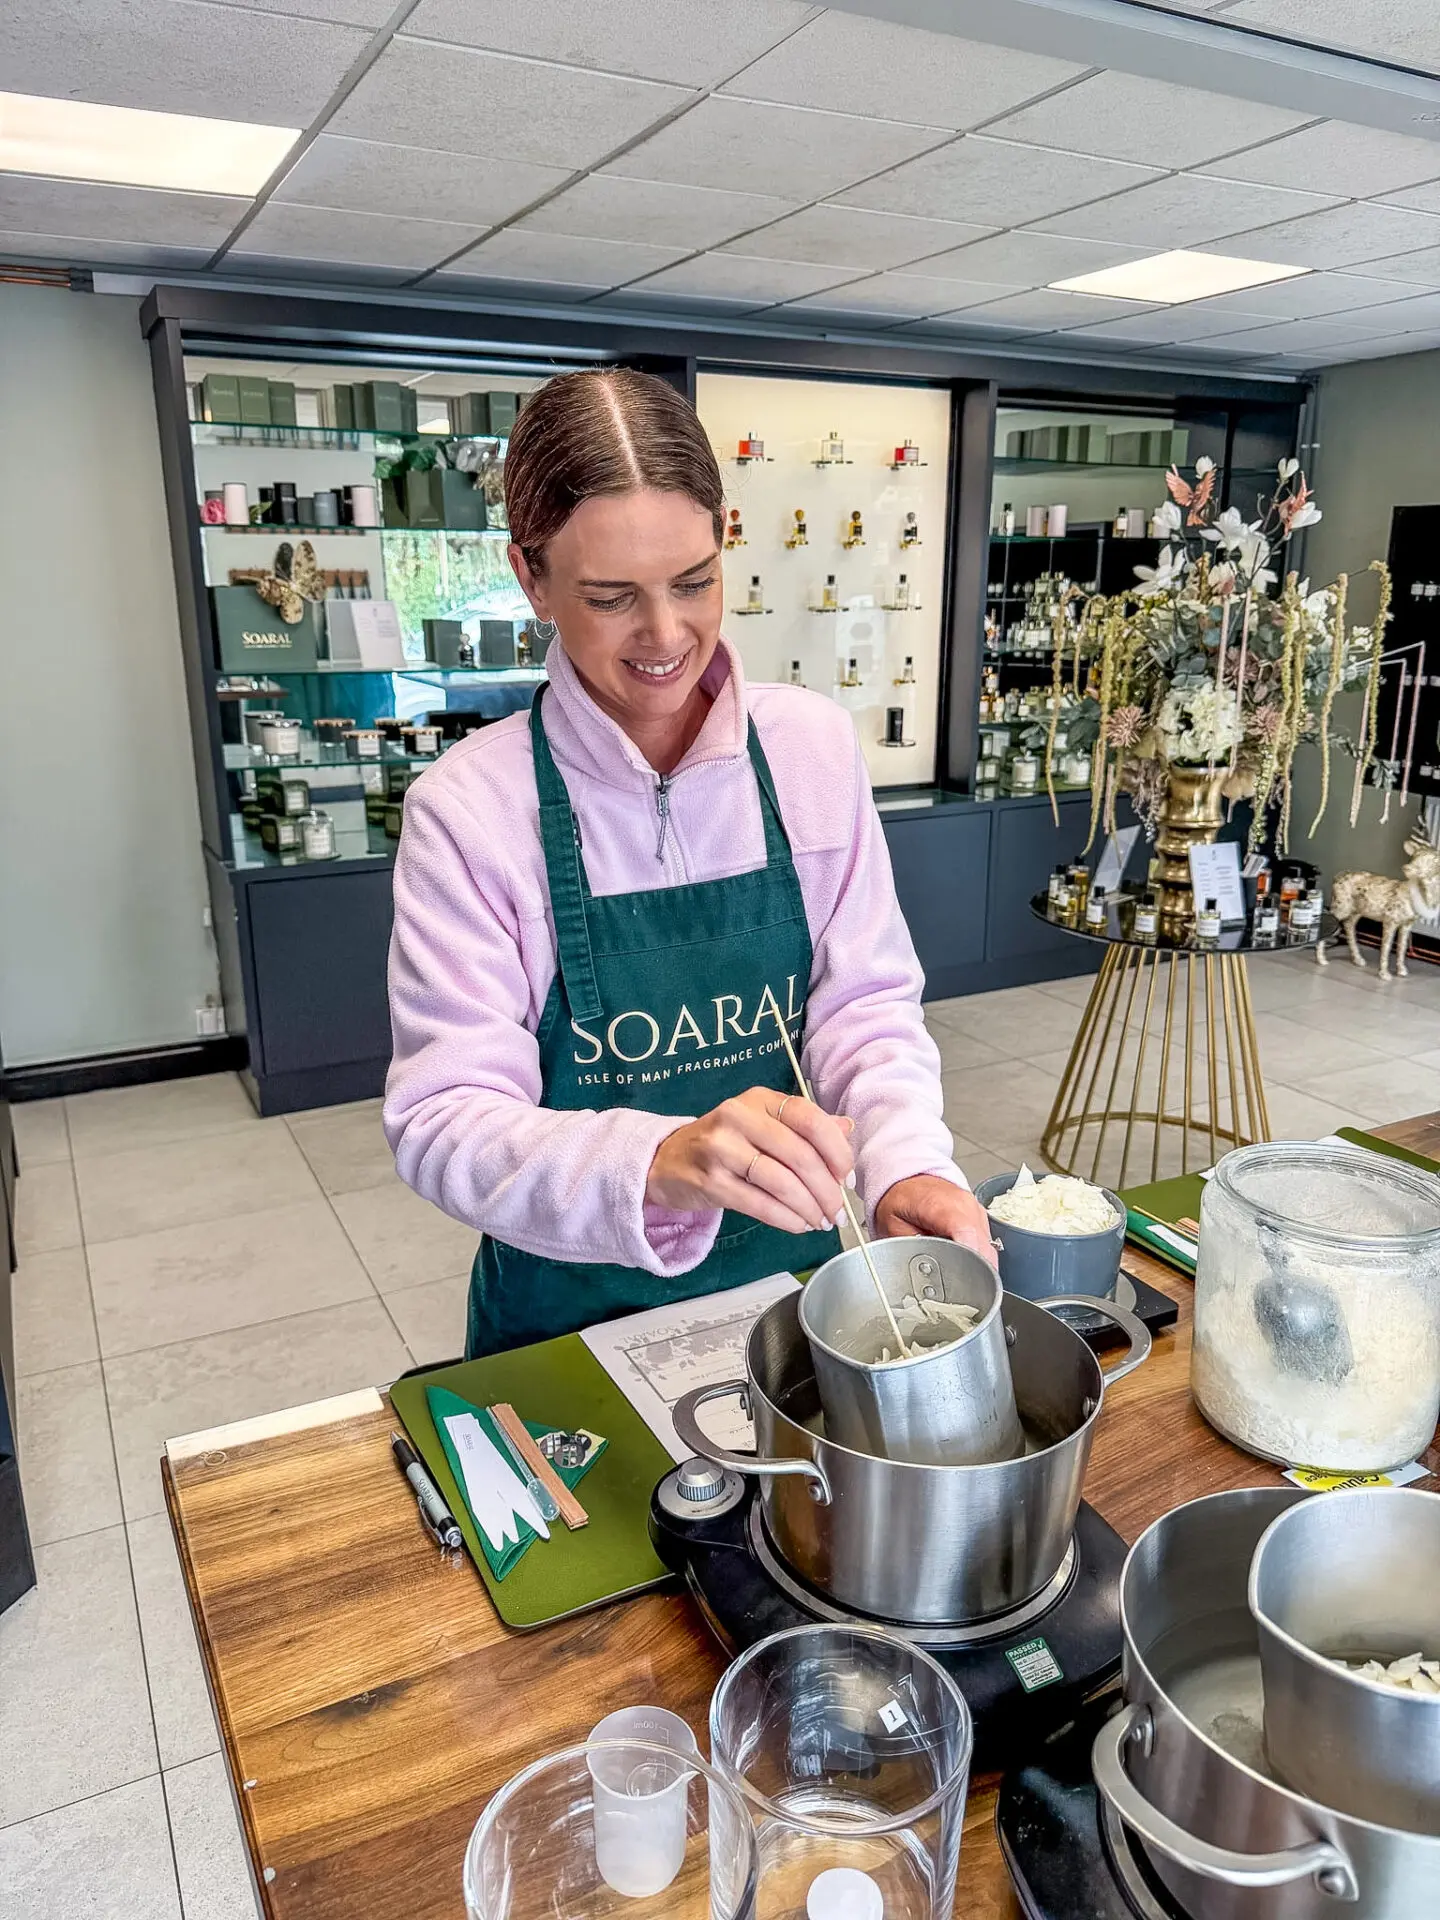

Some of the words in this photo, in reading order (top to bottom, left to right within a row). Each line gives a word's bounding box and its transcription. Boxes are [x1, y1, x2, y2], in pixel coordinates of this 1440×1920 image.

[571, 974, 804, 1064] SOARAL
[578, 1073, 610, 1086] ISLE
[616, 1074, 634, 1085] OF
[642, 1069, 671, 1083] MAN
[677, 1048, 753, 1074] FRAGRANCE
[758, 1029, 800, 1055] COMPNY
[1008, 1642, 1037, 1658] PASSED
[887, 1709, 898, 1722] 1
